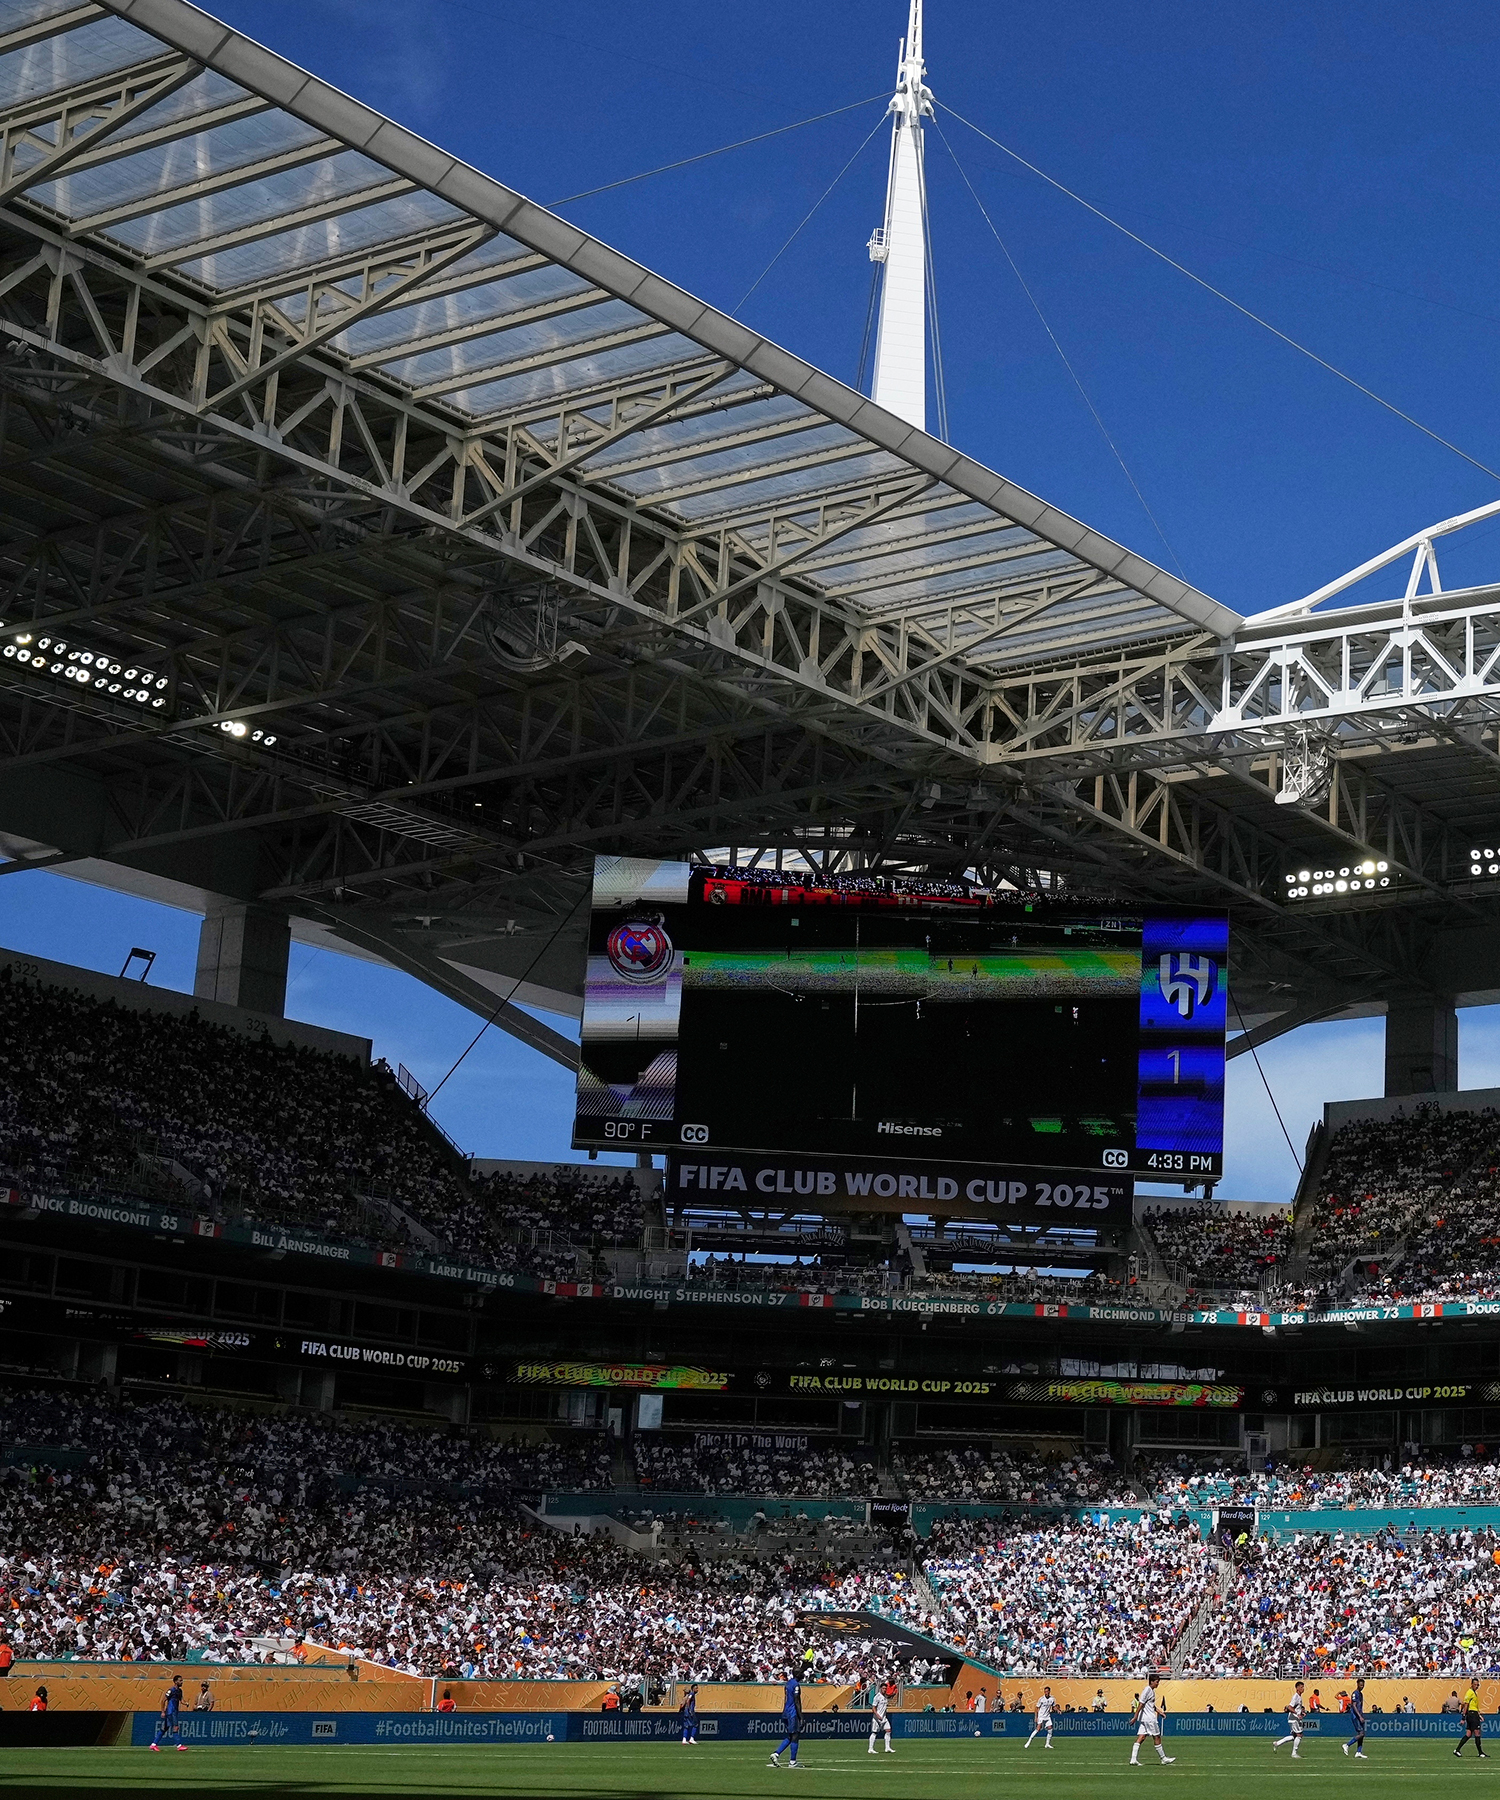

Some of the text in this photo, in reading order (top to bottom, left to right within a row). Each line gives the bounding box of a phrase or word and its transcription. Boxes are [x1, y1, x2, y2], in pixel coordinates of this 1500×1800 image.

[14, 961, 39, 978] 322
[1168, 1050, 1180, 1084] 1
[641, 1124, 652, 1139] F
[682, 1126, 707, 1141] CC
[877, 1122, 942, 1137] Hisense
[1104, 1151, 1127, 1166] CC
[1148, 1154, 1213, 1171] 4:33 PM
[679, 1164, 748, 1192] FIFA
[755, 1169, 836, 1195] CLUB
[845, 1172, 959, 1200] WORLD
[966, 1179, 1028, 1204] CUP
[1196, 1201, 1221, 1214] 327
[160, 1215, 178, 1230] 85
[500, 1274, 514, 1288] 66
[768, 1293, 788, 1306] 57
[986, 1302, 1006, 1315] 67
[1383, 1307, 1399, 1320] 73
[1201, 1312, 1218, 1324] 78
[301, 1340, 328, 1356] FIFA
[329, 1344, 360, 1360] CLUB
[363, 1348, 404, 1366] WORLD
[407, 1354, 430, 1370] CUP
[517, 1366, 552, 1378] FIFA
[554, 1366, 594, 1380] CLUB
[599, 1368, 658, 1382] WORLD
[658, 1370, 688, 1383] CUP
[790, 1376, 821, 1388] FIFA
[824, 1376, 862, 1390] CLUB
[866, 1378, 918, 1392] WORLD
[922, 1380, 951, 1392] CUP
[1294, 1392, 1320, 1404] FIFA
[1323, 1390, 1355, 1403] CLUB
[1357, 1388, 1404, 1402] WORLD
[1406, 1387, 1432, 1399] CUP
[752, 1434, 772, 1448] The
[775, 1436, 808, 1449] World
[872, 1502, 908, 1512] Hard Rock
[1237, 1512, 1254, 1520] Rock
[210, 1720, 247, 1738] UNITES
[316, 1724, 333, 1734] FIFA
[376, 1720, 552, 1738] #FootballUnitesTheWorld
[583, 1718, 667, 1736] FOOTBALL UNITES the
[702, 1724, 716, 1732] FIFA
[1176, 1718, 1216, 1731] FOOTBALL
[1218, 1718, 1246, 1730] UNITES
